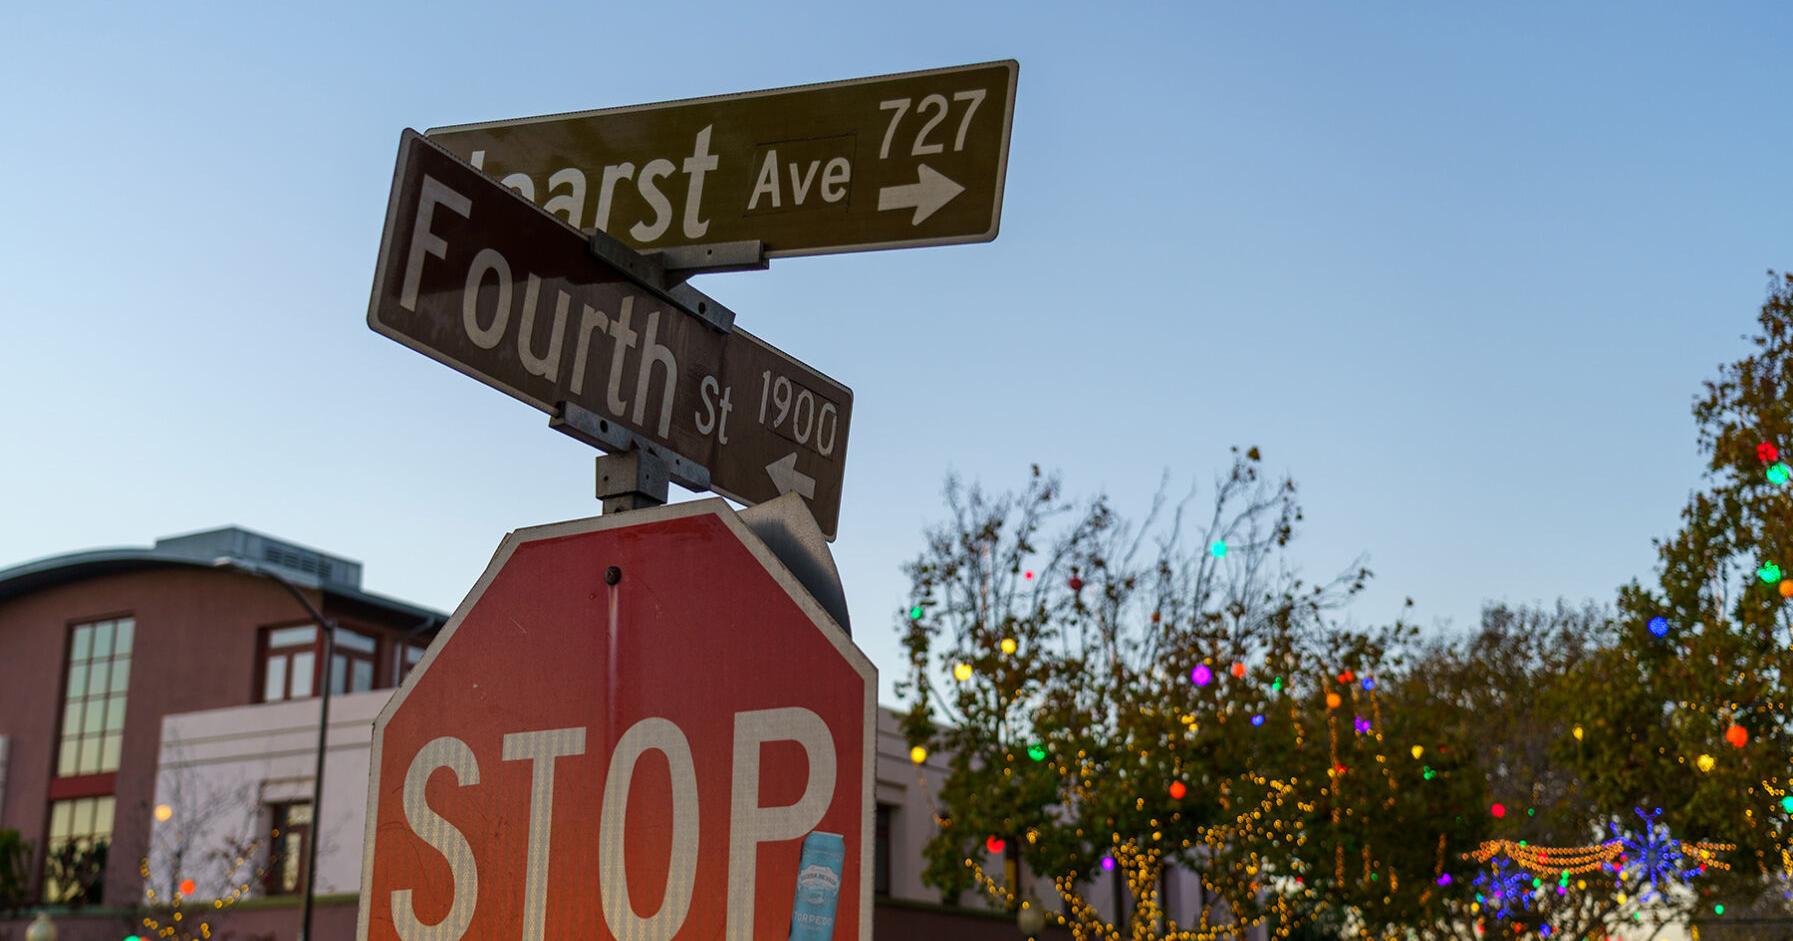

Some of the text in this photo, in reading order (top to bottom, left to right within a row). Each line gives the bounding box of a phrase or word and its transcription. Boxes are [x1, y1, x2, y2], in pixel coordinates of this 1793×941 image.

[470, 124, 851, 242] arst Ave
[879, 88, 987, 160] 727
[400, 173, 733, 445] Fourth St
[758, 370, 837, 457] 1900
[391, 706, 837, 941] STOP
